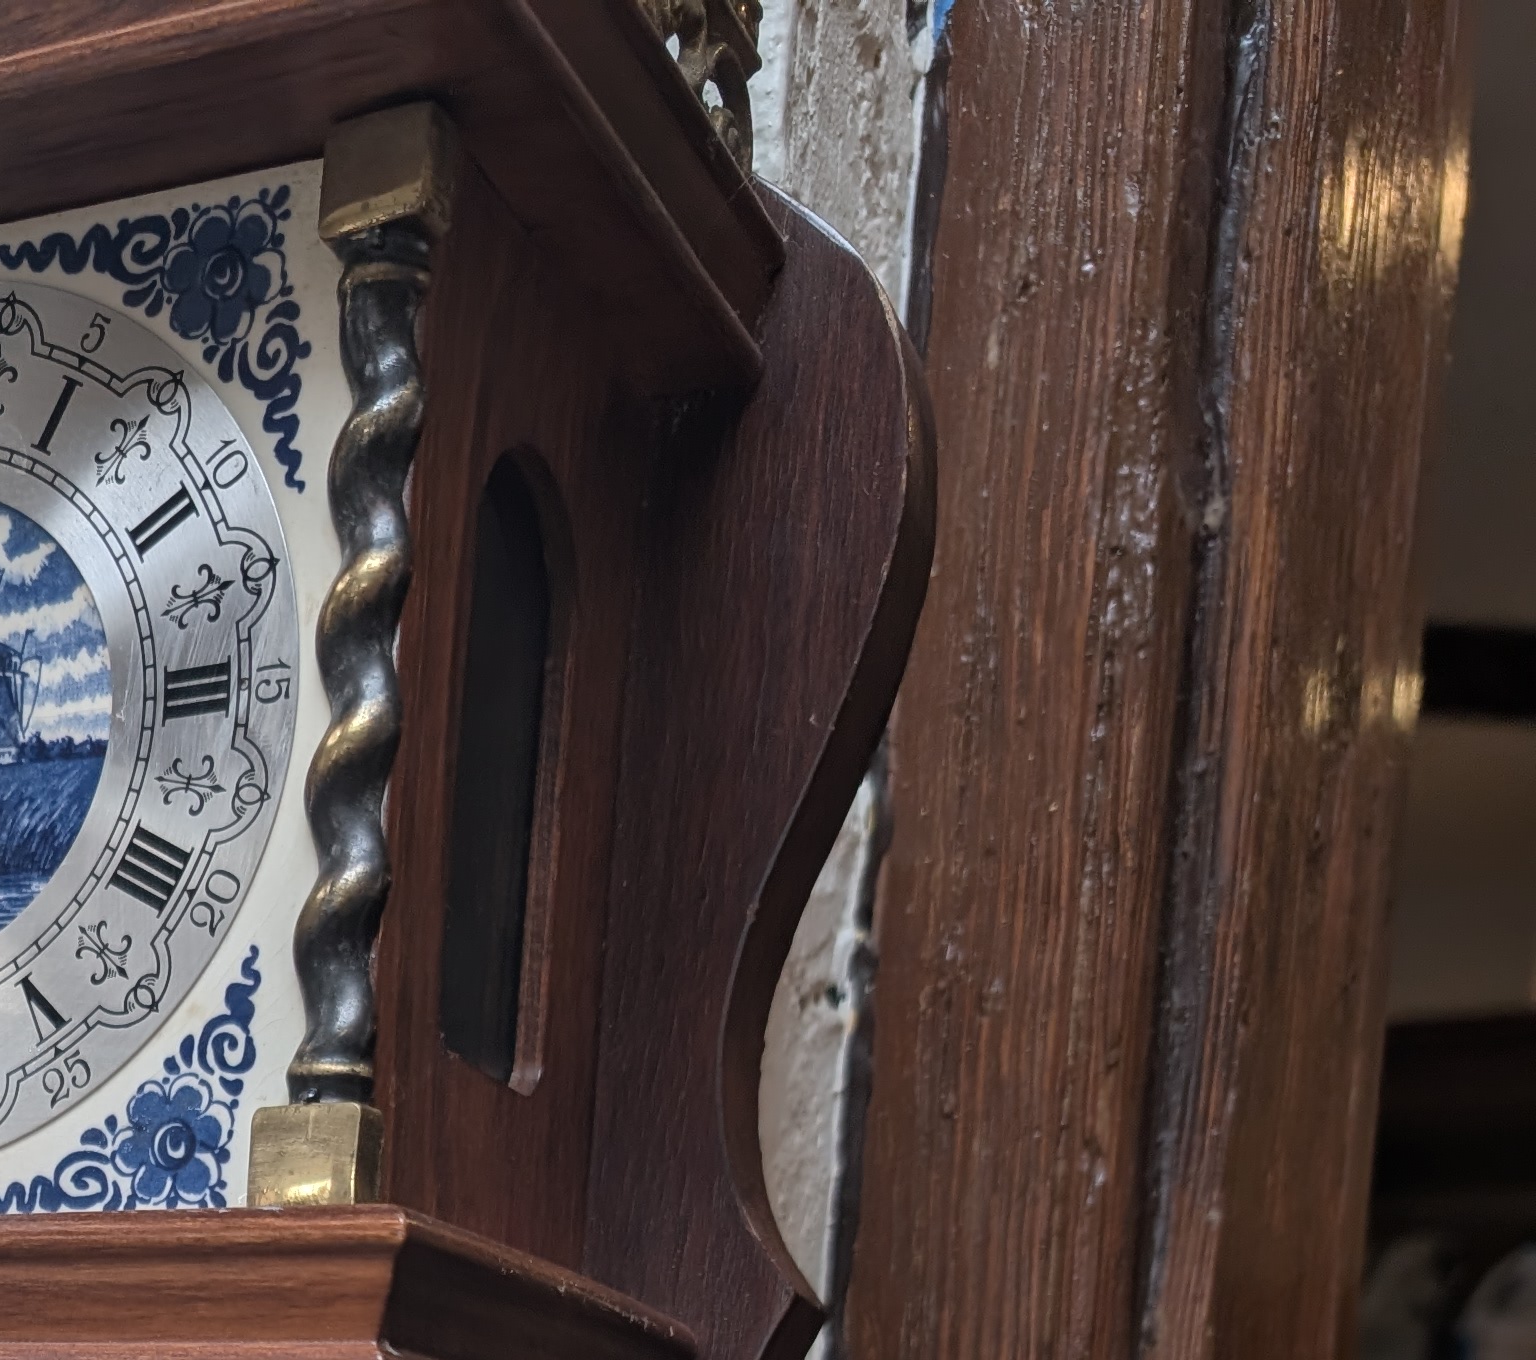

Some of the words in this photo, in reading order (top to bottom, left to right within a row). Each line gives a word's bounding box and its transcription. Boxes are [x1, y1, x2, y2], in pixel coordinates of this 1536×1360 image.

[80, 313, 111, 352] 5
[206, 438, 249, 489] 10
[162, 655, 231, 727] III
[255, 658, 291, 704] 15
[190, 869, 241, 937] 20
[14, 972, 72, 1047] V
[42, 1050, 91, 1109] 25
